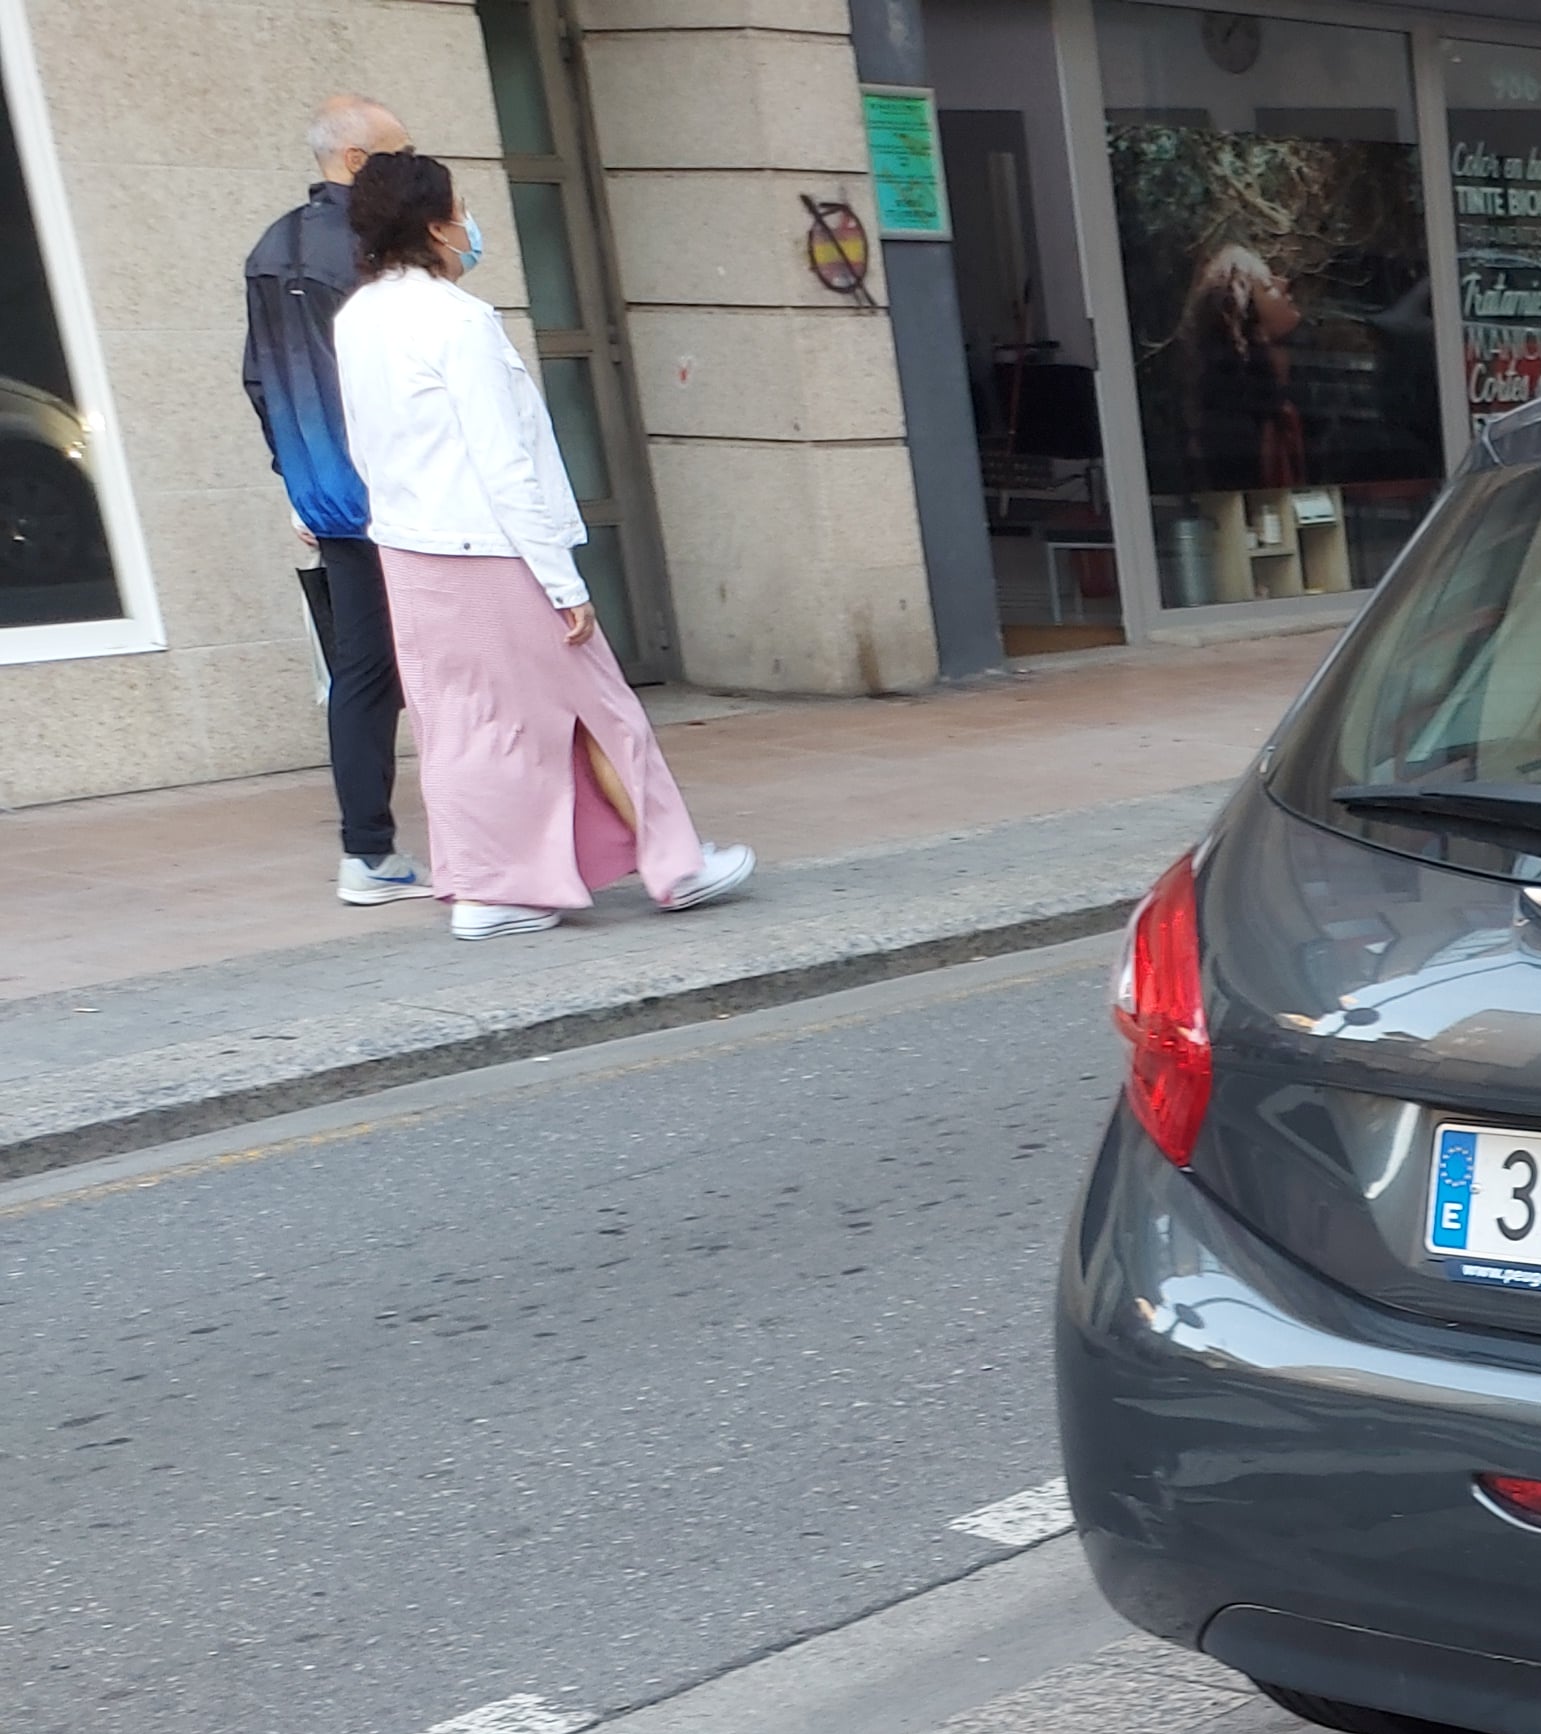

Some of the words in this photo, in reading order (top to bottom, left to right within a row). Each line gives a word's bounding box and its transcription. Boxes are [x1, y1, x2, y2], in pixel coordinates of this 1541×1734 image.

[1455, 186, 1505, 216] TINTE
[1470, 360, 1530, 403] Cortes
[1441, 1203, 1462, 1230] E
